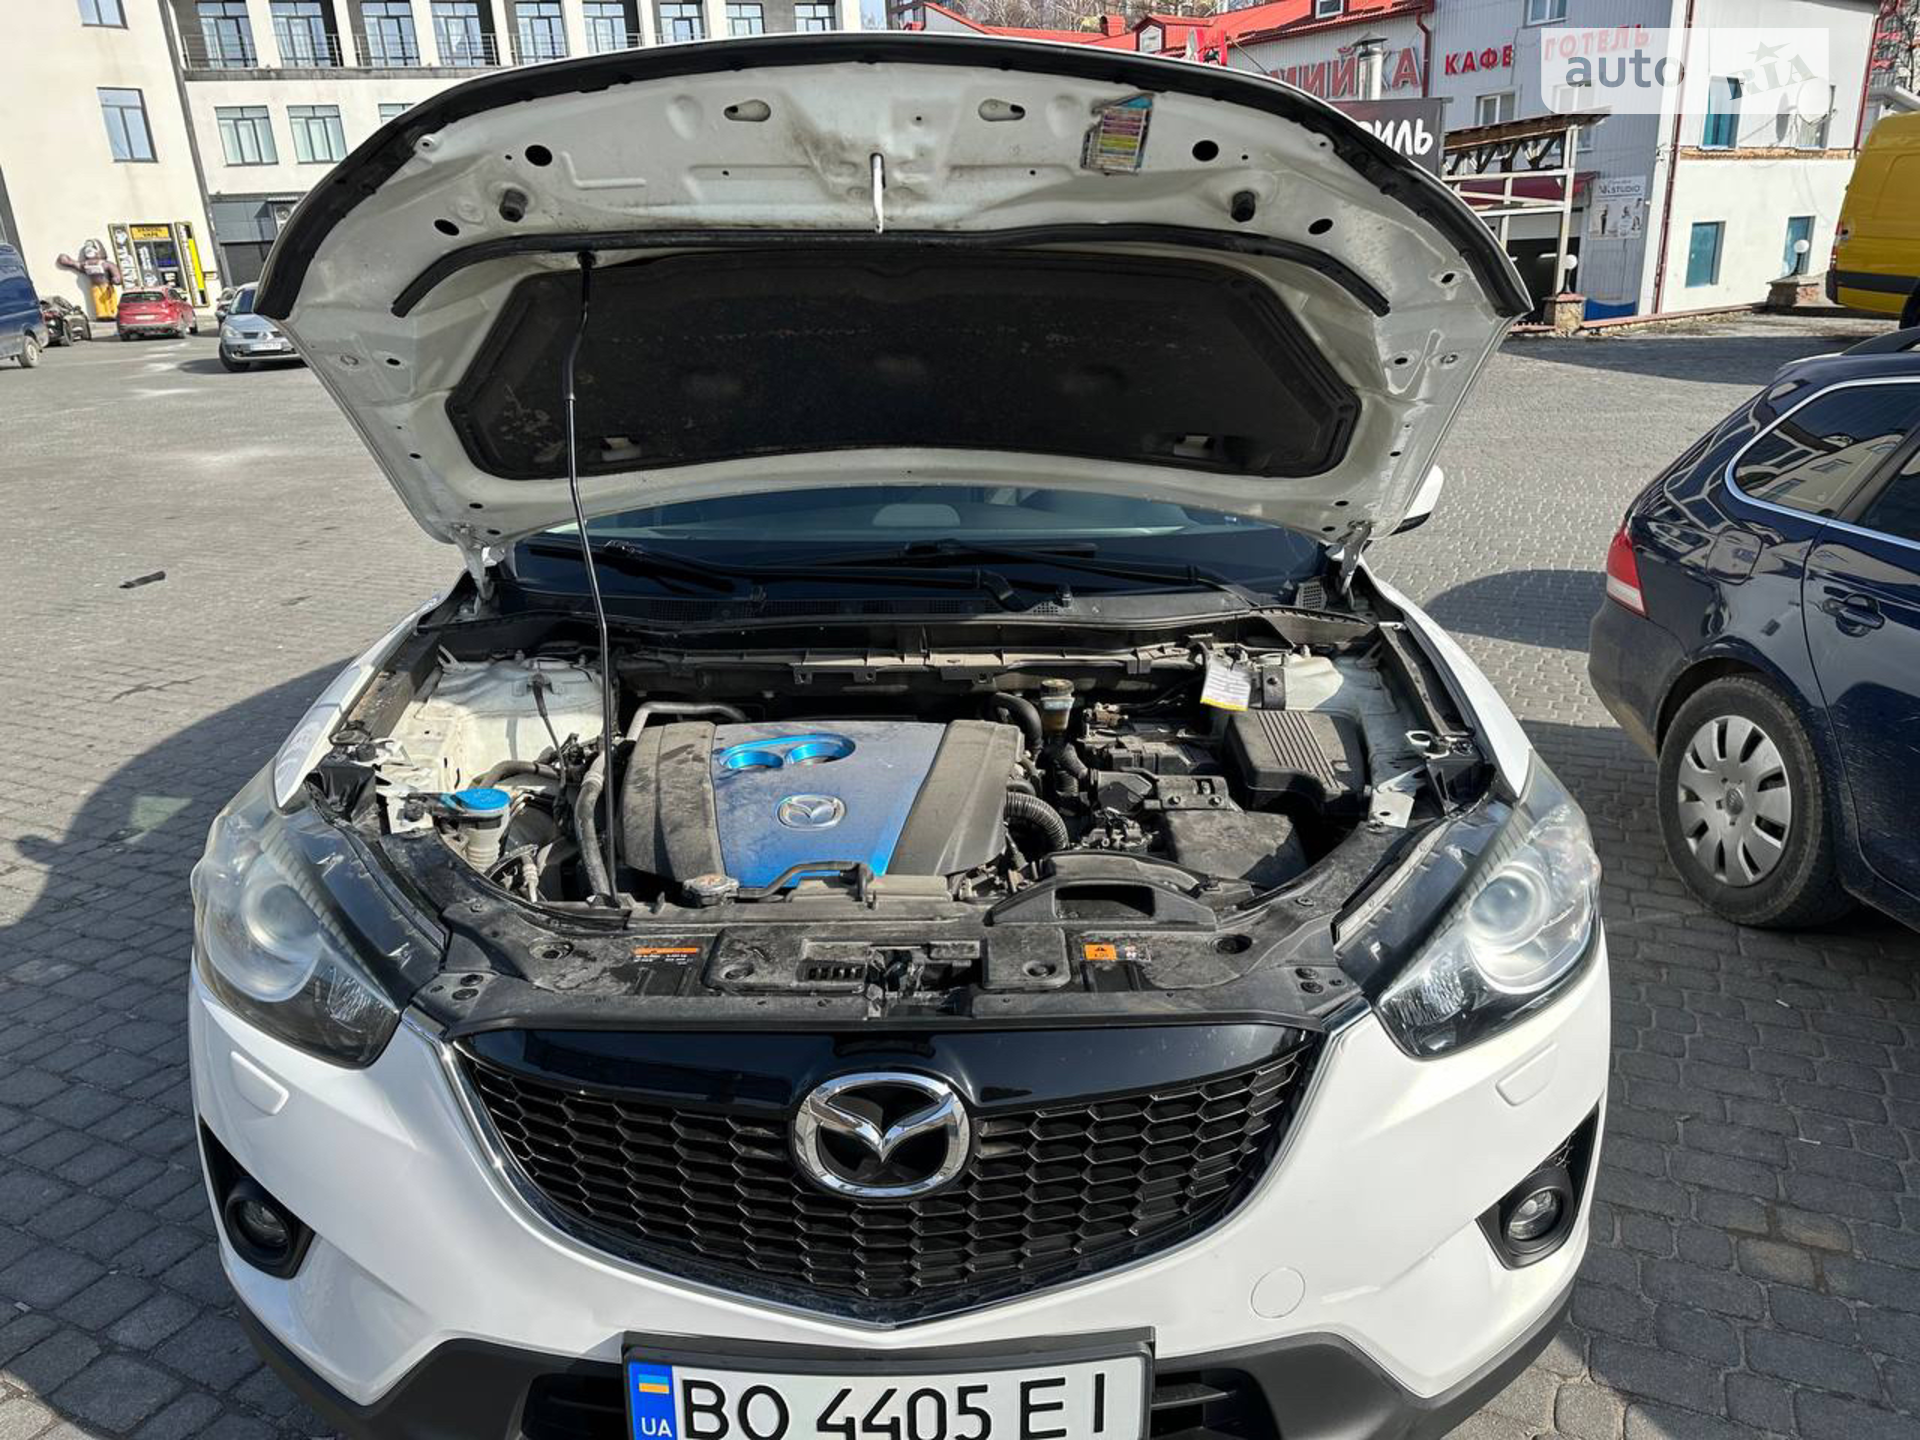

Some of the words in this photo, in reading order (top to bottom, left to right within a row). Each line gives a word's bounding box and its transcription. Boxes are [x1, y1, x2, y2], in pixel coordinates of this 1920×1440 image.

[1445, 44, 1513, 76] КАФЕ
[1543, 23, 1651, 62] ГОТЕЛЬ
[641, 1416, 673, 1437] UA
[682, 1379, 790, 1440] BO
[816, 1384, 992, 1440] 4405
